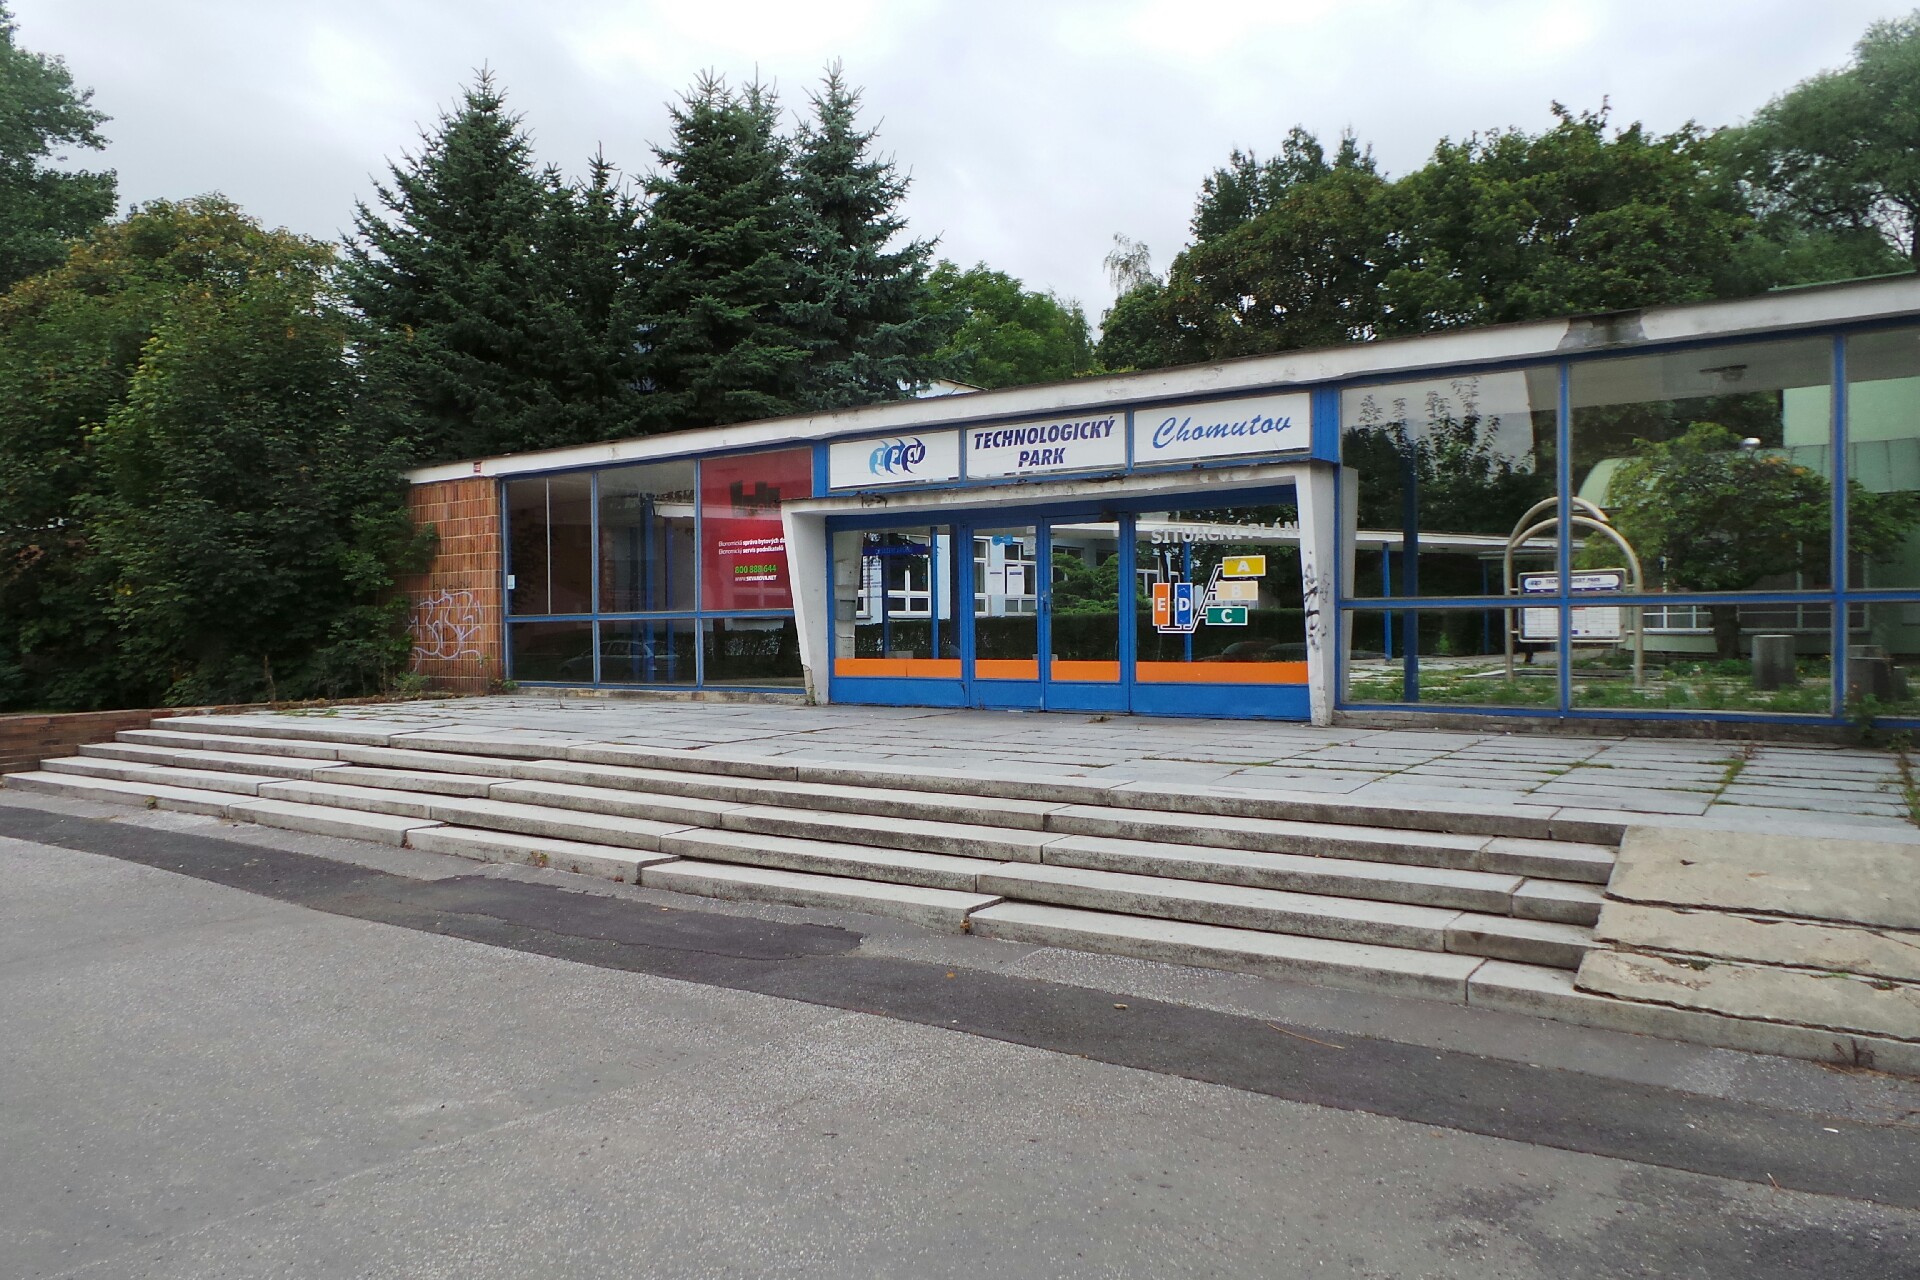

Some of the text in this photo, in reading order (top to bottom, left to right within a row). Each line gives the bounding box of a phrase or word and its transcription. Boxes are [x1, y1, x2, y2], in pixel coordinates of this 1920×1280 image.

[974, 416, 1115, 449] TECHNOLOGICKÝ
[1153, 414, 1291, 449] Chomutov
[1018, 447, 1066, 467] PARK
[1151, 516, 1300, 544] SITUAČNÍ PLÁN
[749, 565, 762, 573] 888
[1237, 560, 1251, 573] A
[1232, 585, 1243, 597] B
[1157, 598, 1166, 611] E
[1178, 598, 1190, 611] D
[1221, 609, 1233, 623] C
